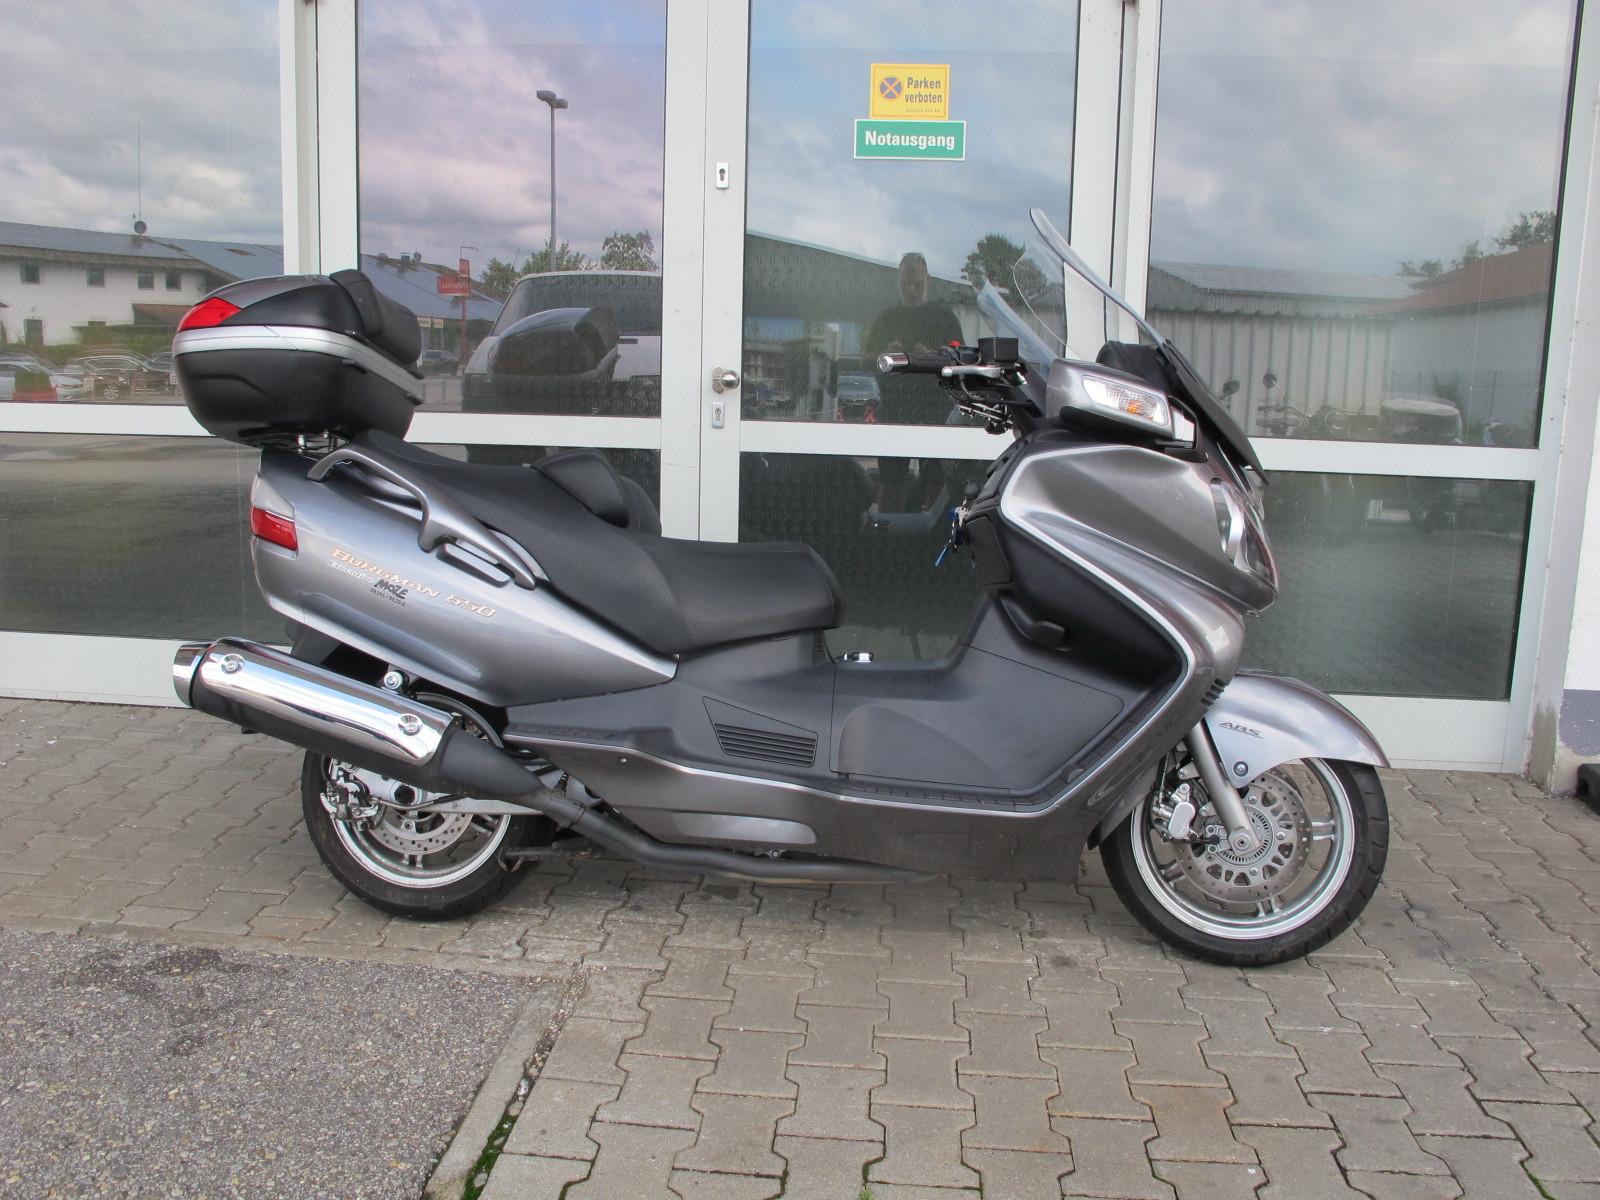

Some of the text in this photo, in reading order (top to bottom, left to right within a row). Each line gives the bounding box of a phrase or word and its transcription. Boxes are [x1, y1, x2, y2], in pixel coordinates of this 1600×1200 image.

[906, 77, 941, 89] Parken
[905, 92, 942, 103] verboten
[865, 130, 955, 150] Notausgang
[445, 594, 497, 617] 650
[1219, 722, 1263, 738] ABS
